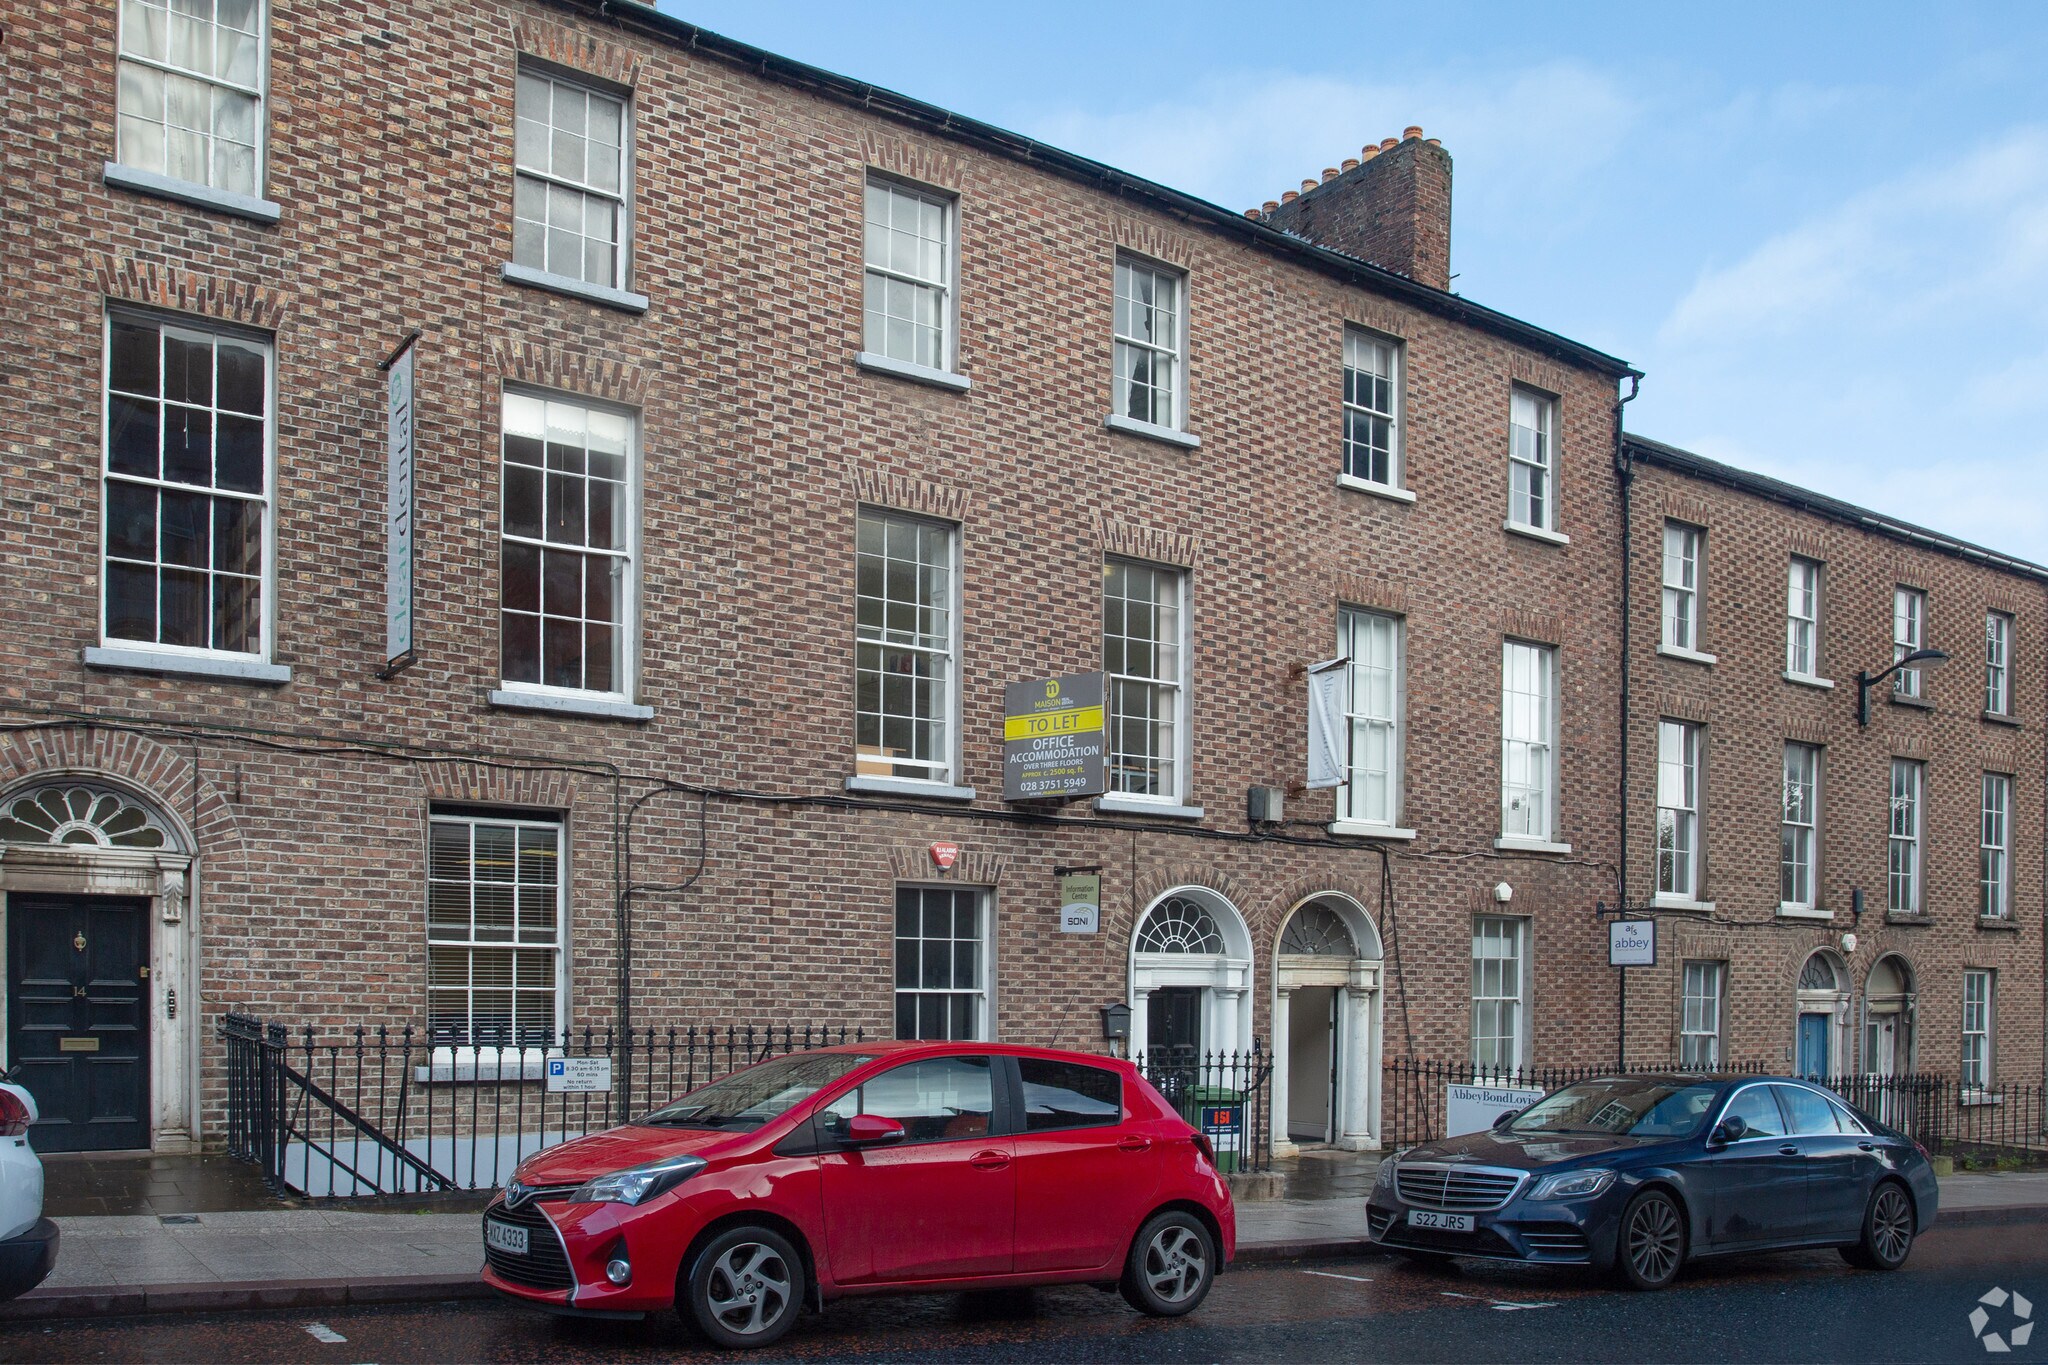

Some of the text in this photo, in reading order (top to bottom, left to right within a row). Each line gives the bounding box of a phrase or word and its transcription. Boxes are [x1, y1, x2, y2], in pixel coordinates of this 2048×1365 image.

[394, 401, 408, 643] cleardental
[1034, 698, 1061, 709] MAISON
[1028, 714, 1080, 733] TO LET
[1032, 735, 1075, 750] OFFICE
[1009, 745, 1099, 764] ACCOMMODATION
[1023, 758, 1084, 770] OVER THREE FLOORS
[1022, 771, 1041, 779] APPROX
[1050, 767, 1065, 776] 2500
[1067, 767, 1076, 776] sq.
[1020, 777, 1087, 792] 028 3751 5949
[1068, 918, 1088, 926] SONI
[1615, 937, 1649, 950] abbey
[73, 986, 87, 996] 14
[1452, 1088, 1536, 1104] AbbeyBondLovis
[1416, 1213, 1464, 1229] S22 JRS
[502, 1227, 524, 1248] 4333
